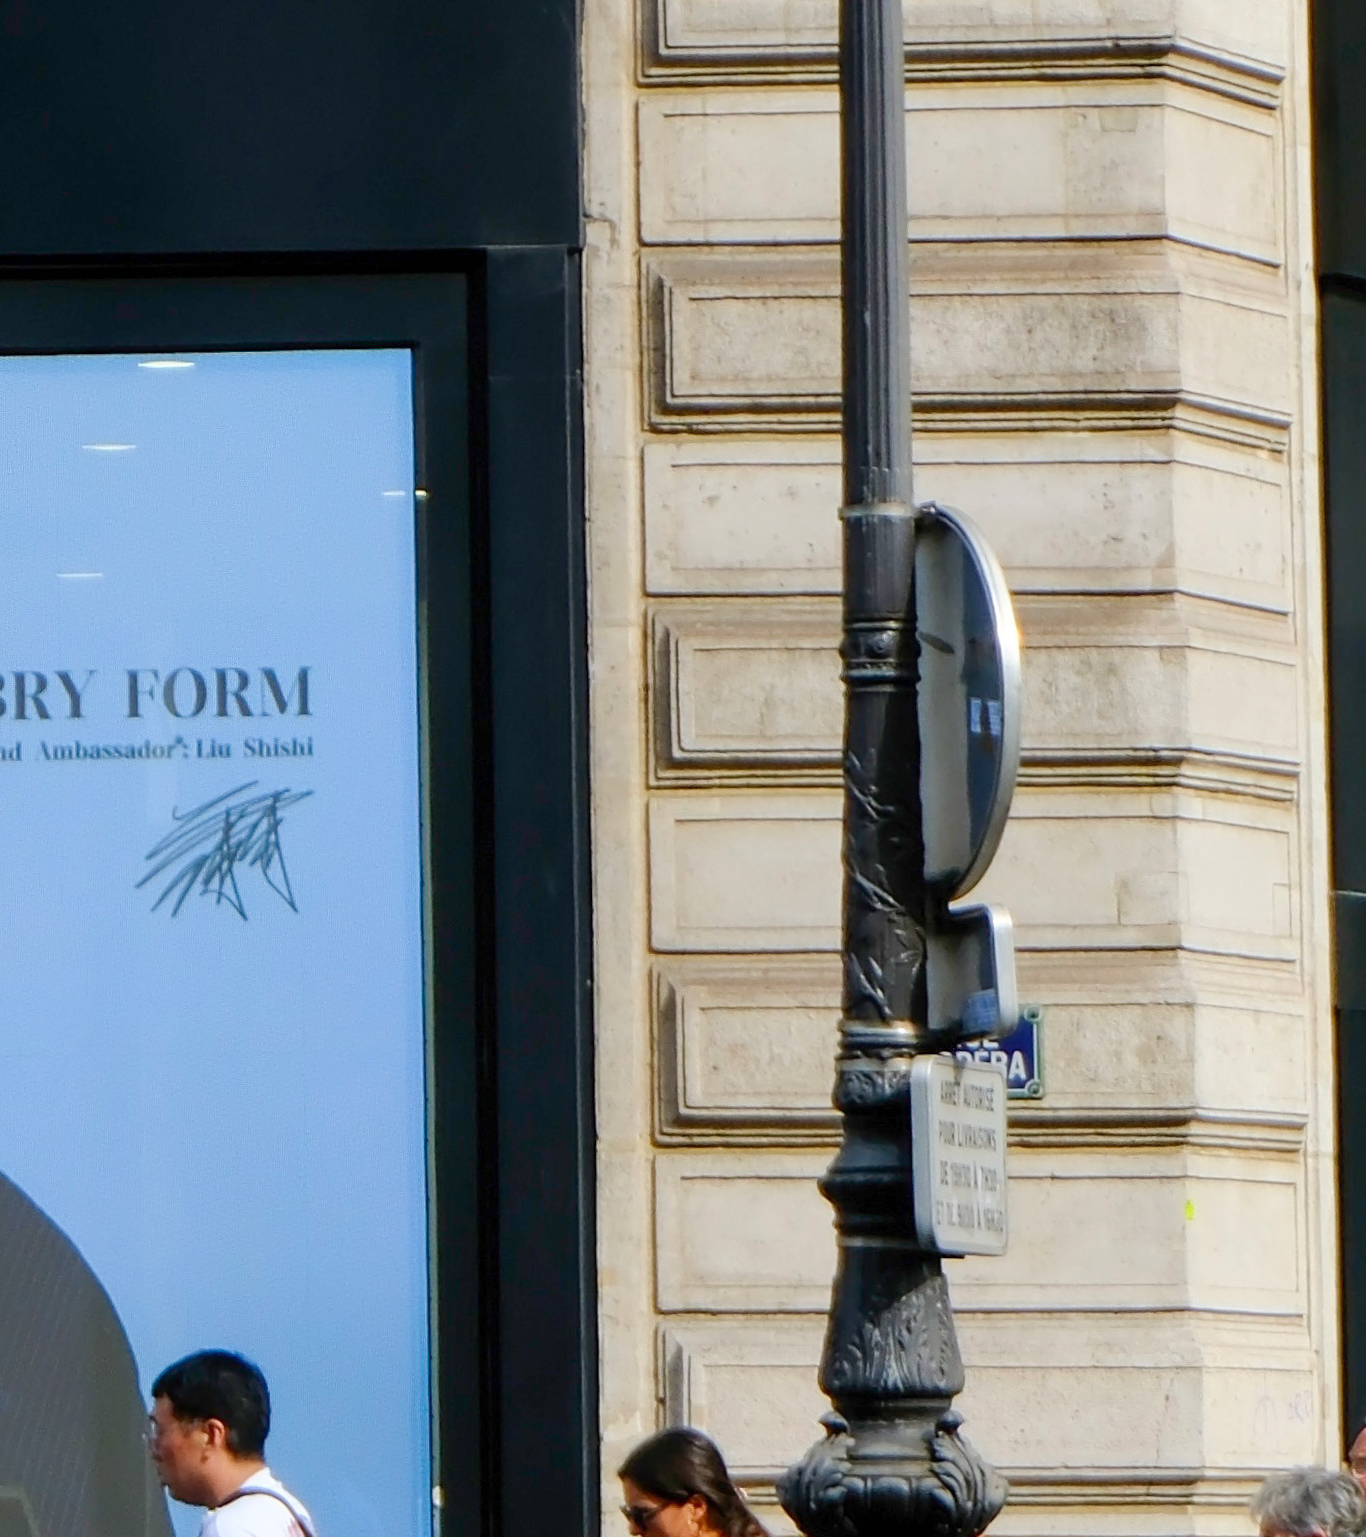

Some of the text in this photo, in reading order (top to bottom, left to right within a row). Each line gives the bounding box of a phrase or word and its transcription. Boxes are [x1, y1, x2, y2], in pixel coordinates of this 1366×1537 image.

[125, 666, 313, 718] FORM
[195, 738, 232, 760] Liu
[243, 735, 314, 759] Shishi
